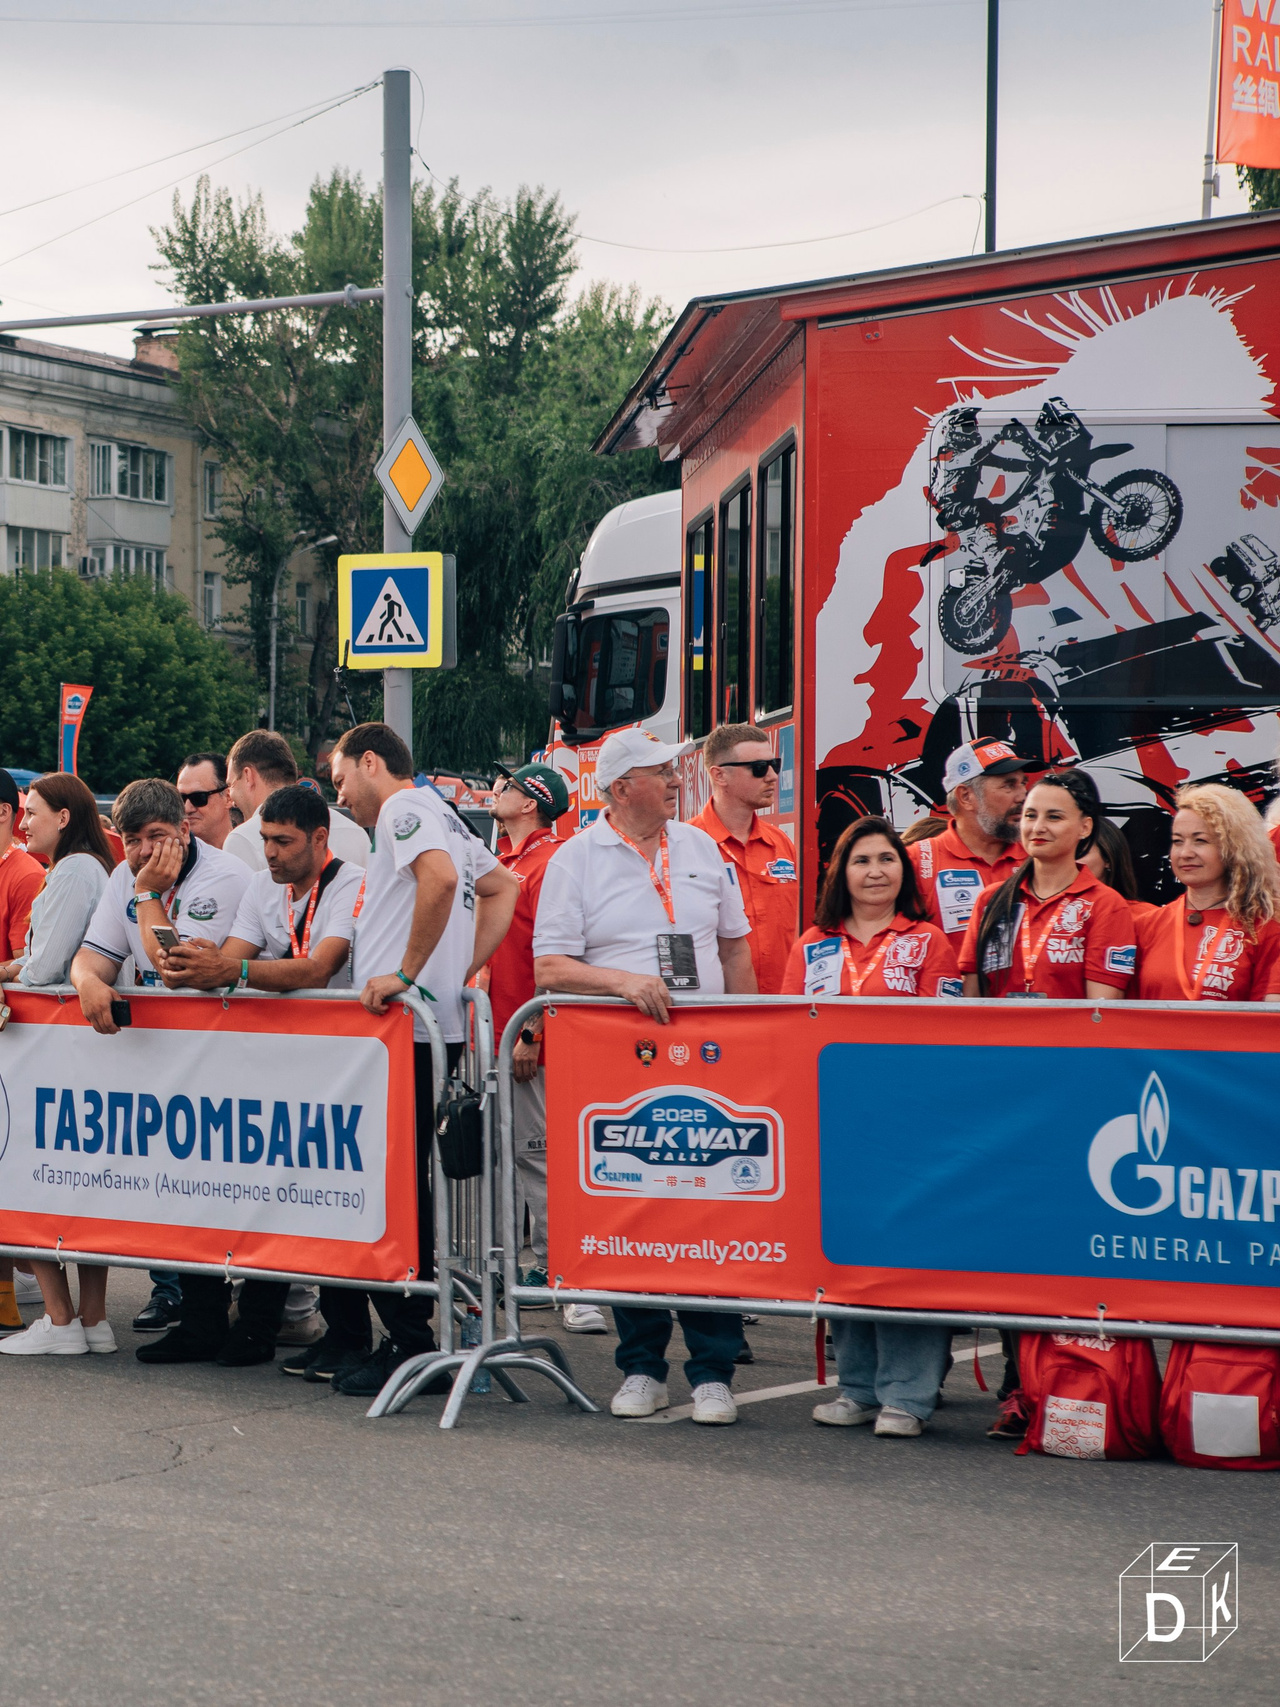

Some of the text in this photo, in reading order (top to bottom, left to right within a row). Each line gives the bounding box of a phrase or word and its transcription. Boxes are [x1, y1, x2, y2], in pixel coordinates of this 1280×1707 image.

[1046, 949, 1086, 964] WAY
[672, 977, 690, 986] VIP
[883, 966, 919, 981] SILK
[883, 978, 919, 995] WAY
[651, 1108, 708, 1123] 2025
[34, 1087, 364, 1172] ГАЗПРОМБАНК
[601, 1125, 760, 1150] SILK WAY
[648, 1151, 712, 1163] RALLY
[32, 1163, 366, 1214] «Газпромбанк» (Акционерное общество)
[580, 1235, 787, 1265] #silkwayrally2025
[1090, 1233, 1231, 1264] GENERAL
[1077, 1337, 1116, 1352] WAY
[1049, 1412, 1105, 1430] Екатерина
